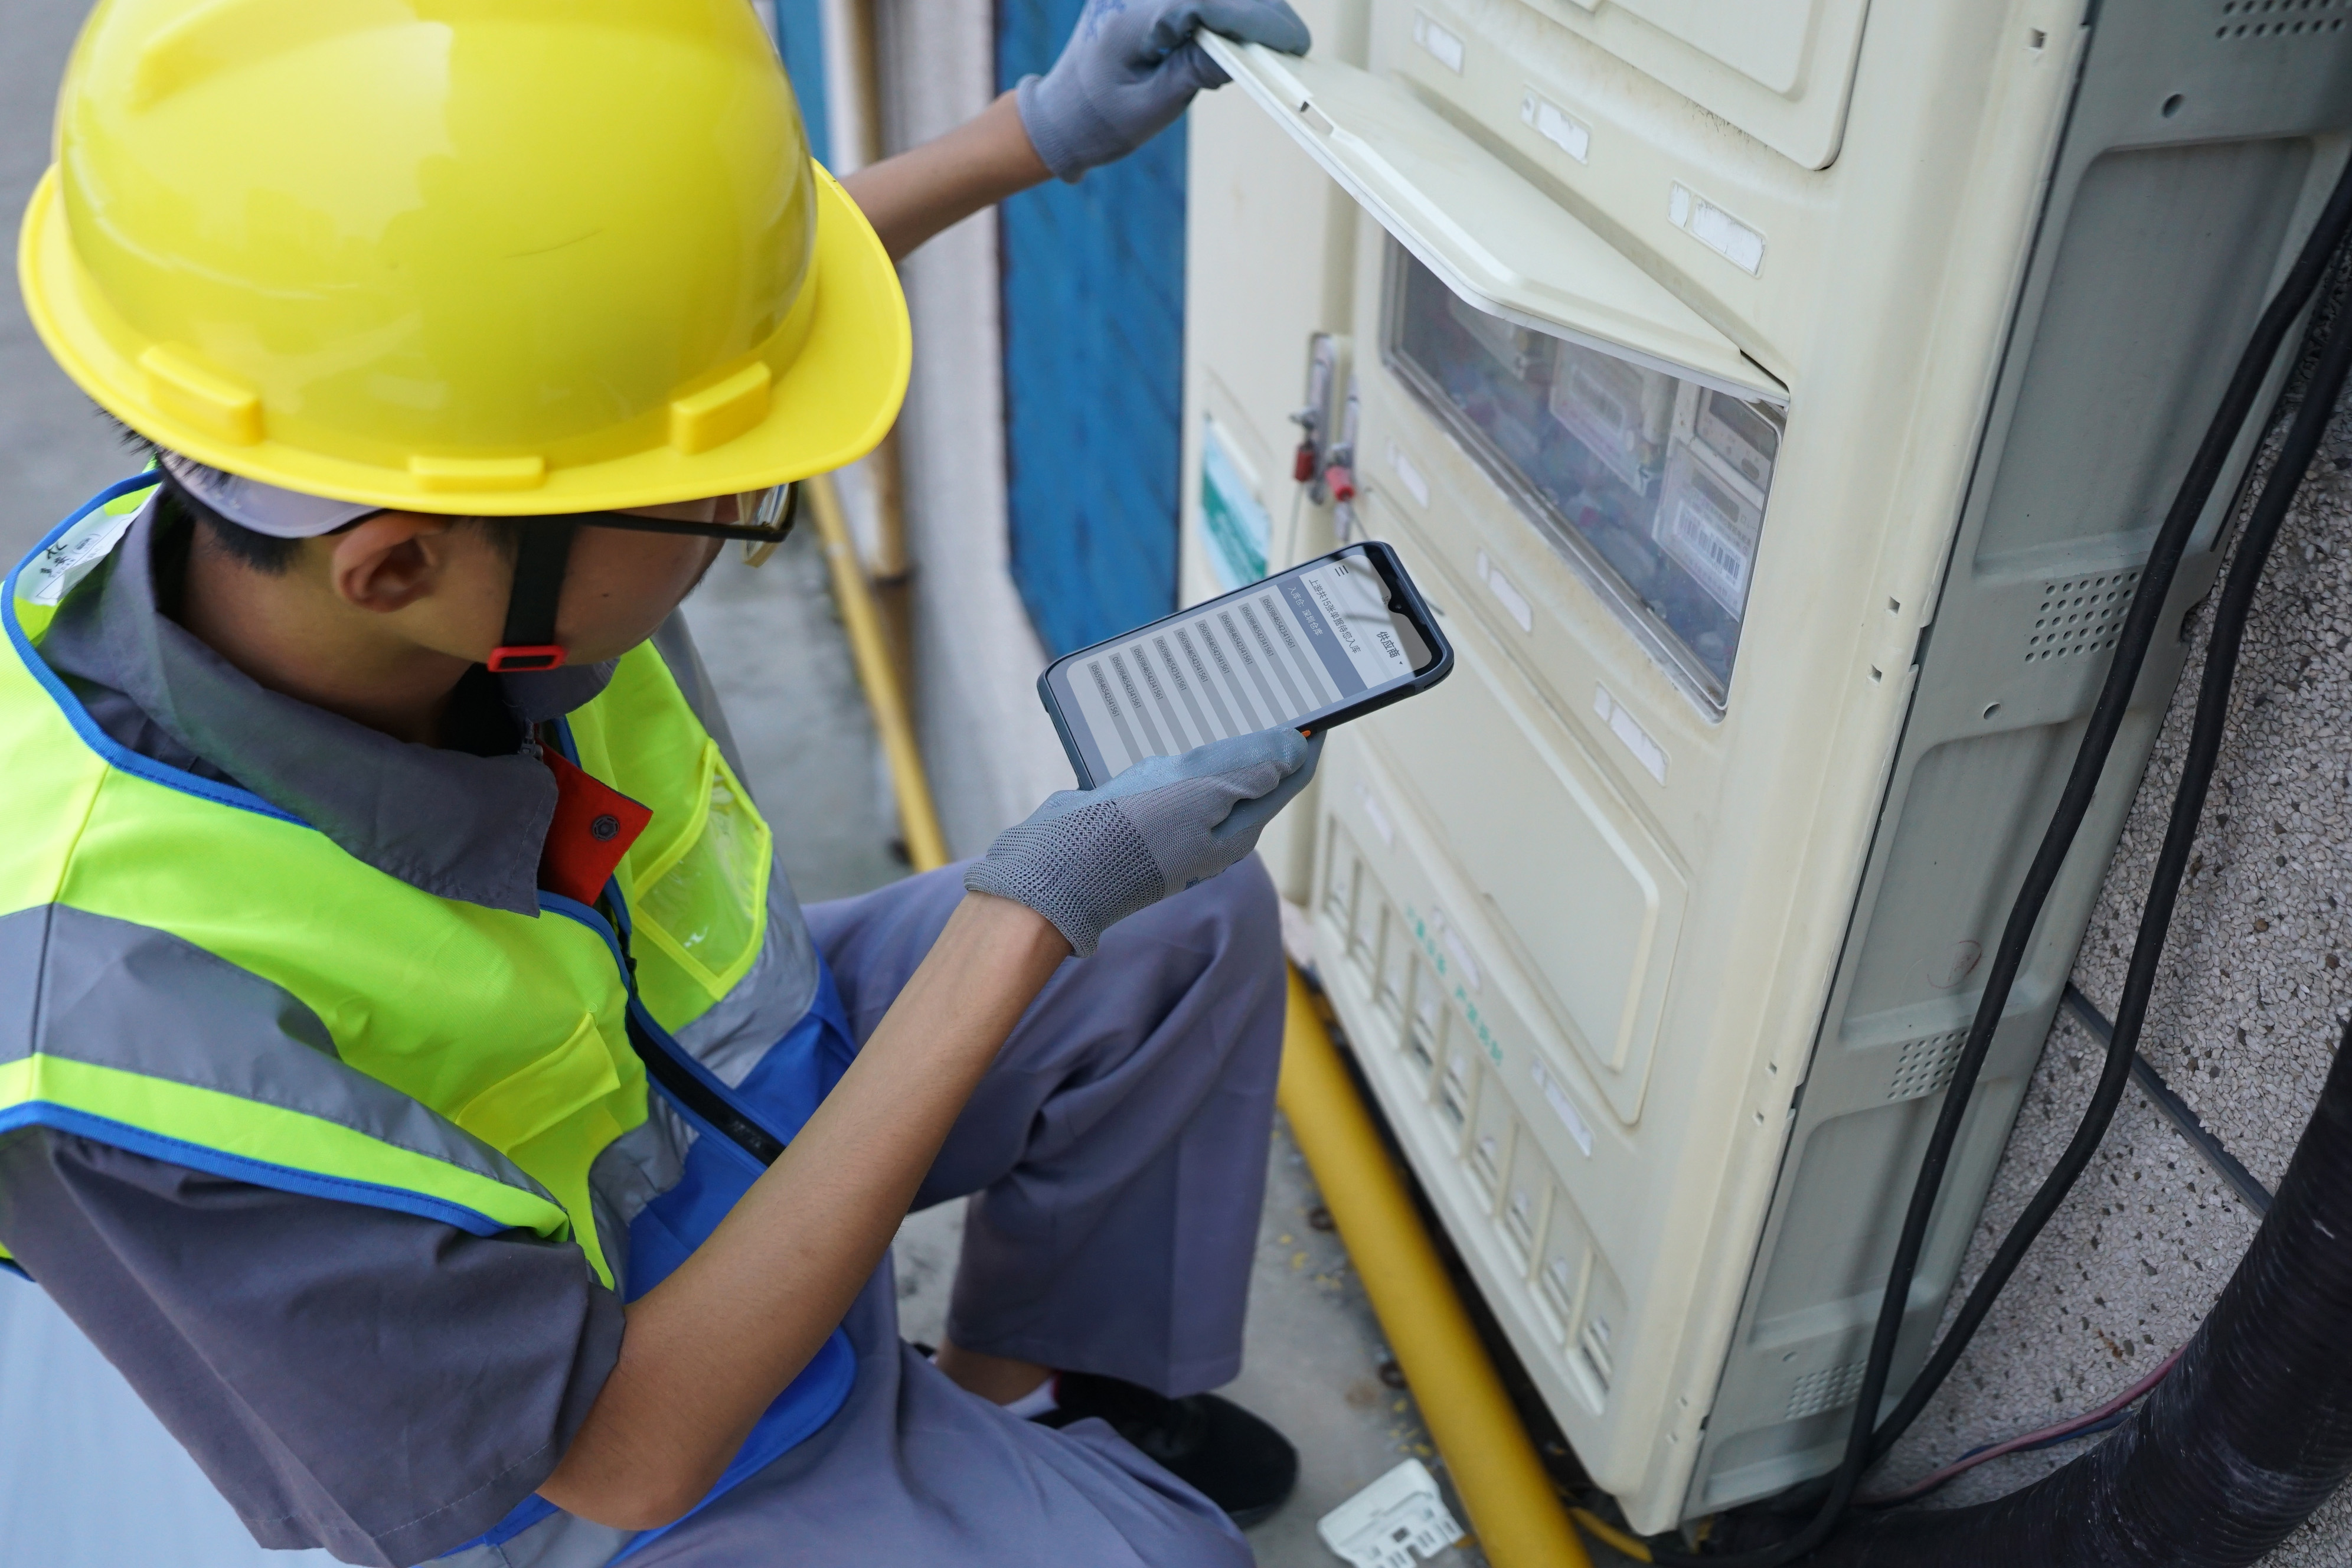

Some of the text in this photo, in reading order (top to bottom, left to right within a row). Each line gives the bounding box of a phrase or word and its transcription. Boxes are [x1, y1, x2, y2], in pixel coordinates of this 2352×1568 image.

[1221, 615, 1253, 665] 05659846542341561
[1242, 607, 1274, 657] 05659846542341561
[1263, 599, 1295, 648] 05659846542341561
[1308, 579, 1361, 654] 上游共15张单据待您入库
[1157, 639, 1187, 691] 05659846542341561
[1177, 632, 1208, 682] 05659846542341561
[1198, 623, 1230, 674] 05659846542341561
[1376, 631, 1400, 658] 供应商
[1090, 665, 1119, 717] 05659846542341561
[1112, 656, 1141, 709] 05659846542341561
[1133, 649, 1163, 700] 05659846542341561
